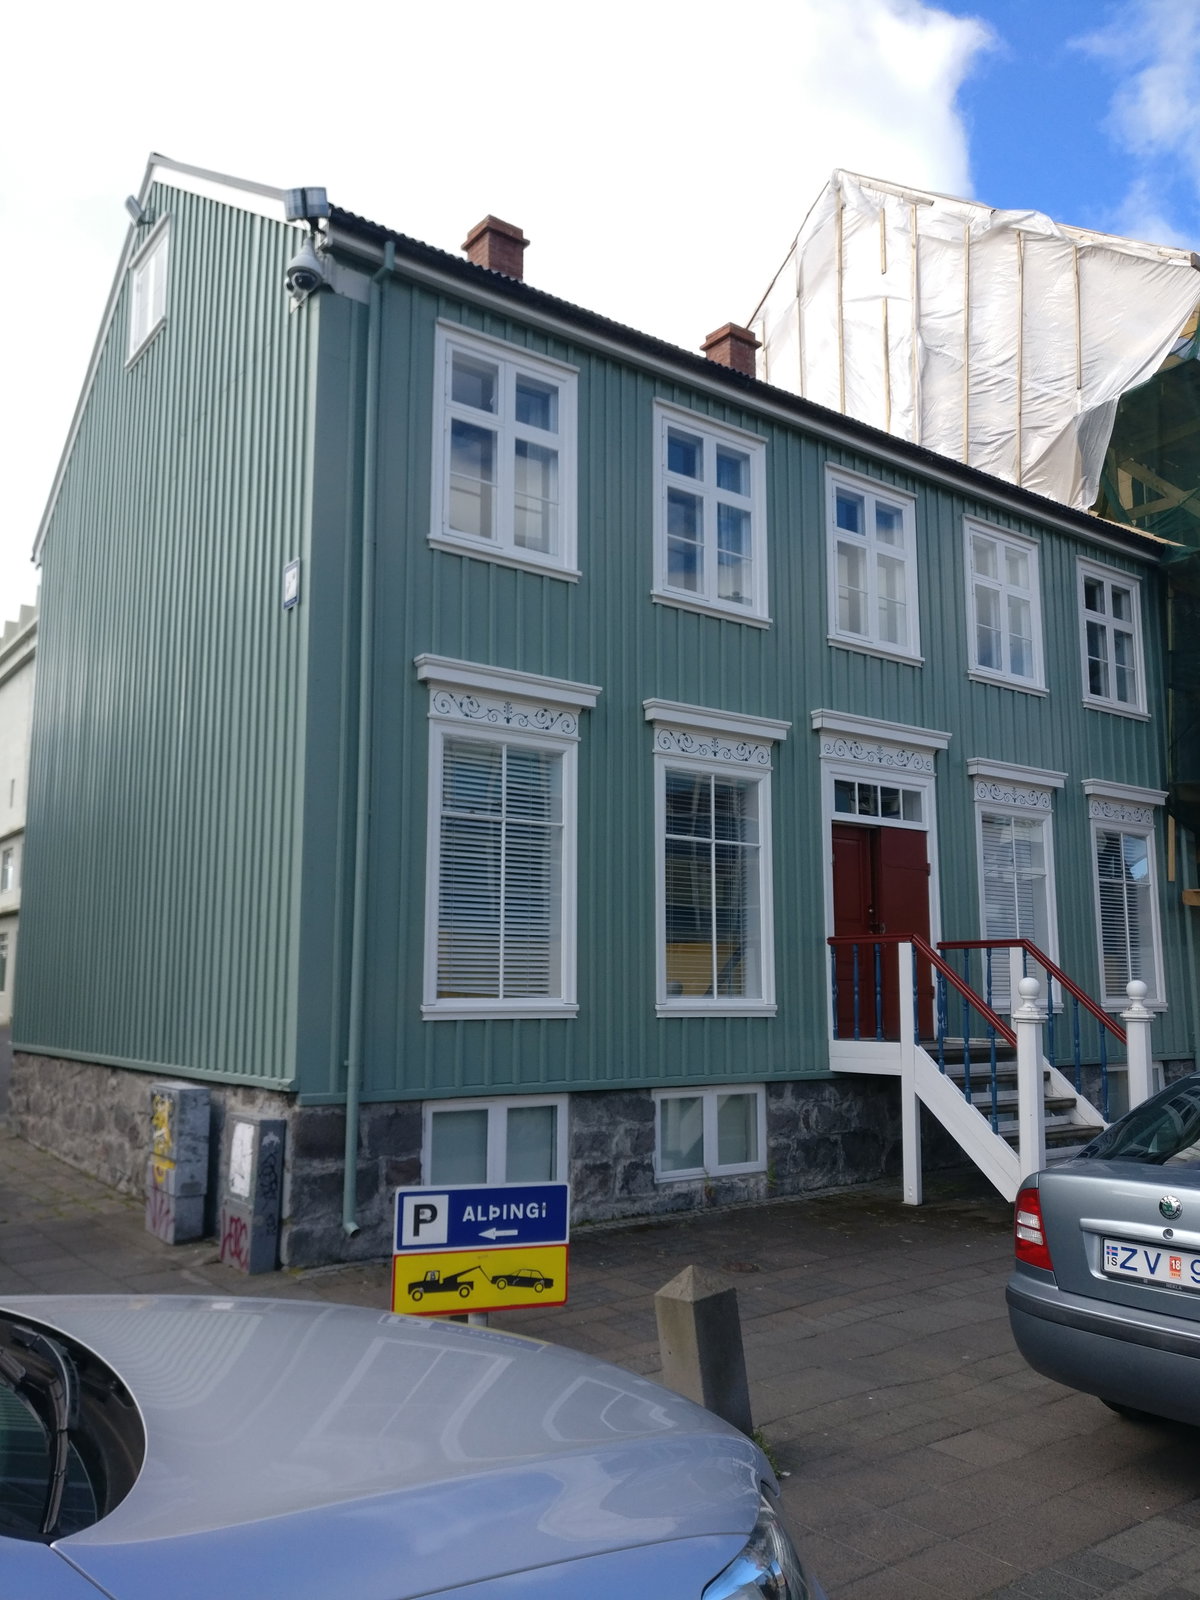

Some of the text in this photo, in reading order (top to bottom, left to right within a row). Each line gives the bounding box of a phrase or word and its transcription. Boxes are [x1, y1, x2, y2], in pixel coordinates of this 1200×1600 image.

[413, 1204, 438, 1237] P
[1106, 1255, 1118, 1267] IS
[1120, 1246, 1161, 1275] ZV
[1171, 1259, 1181, 1270] 18
